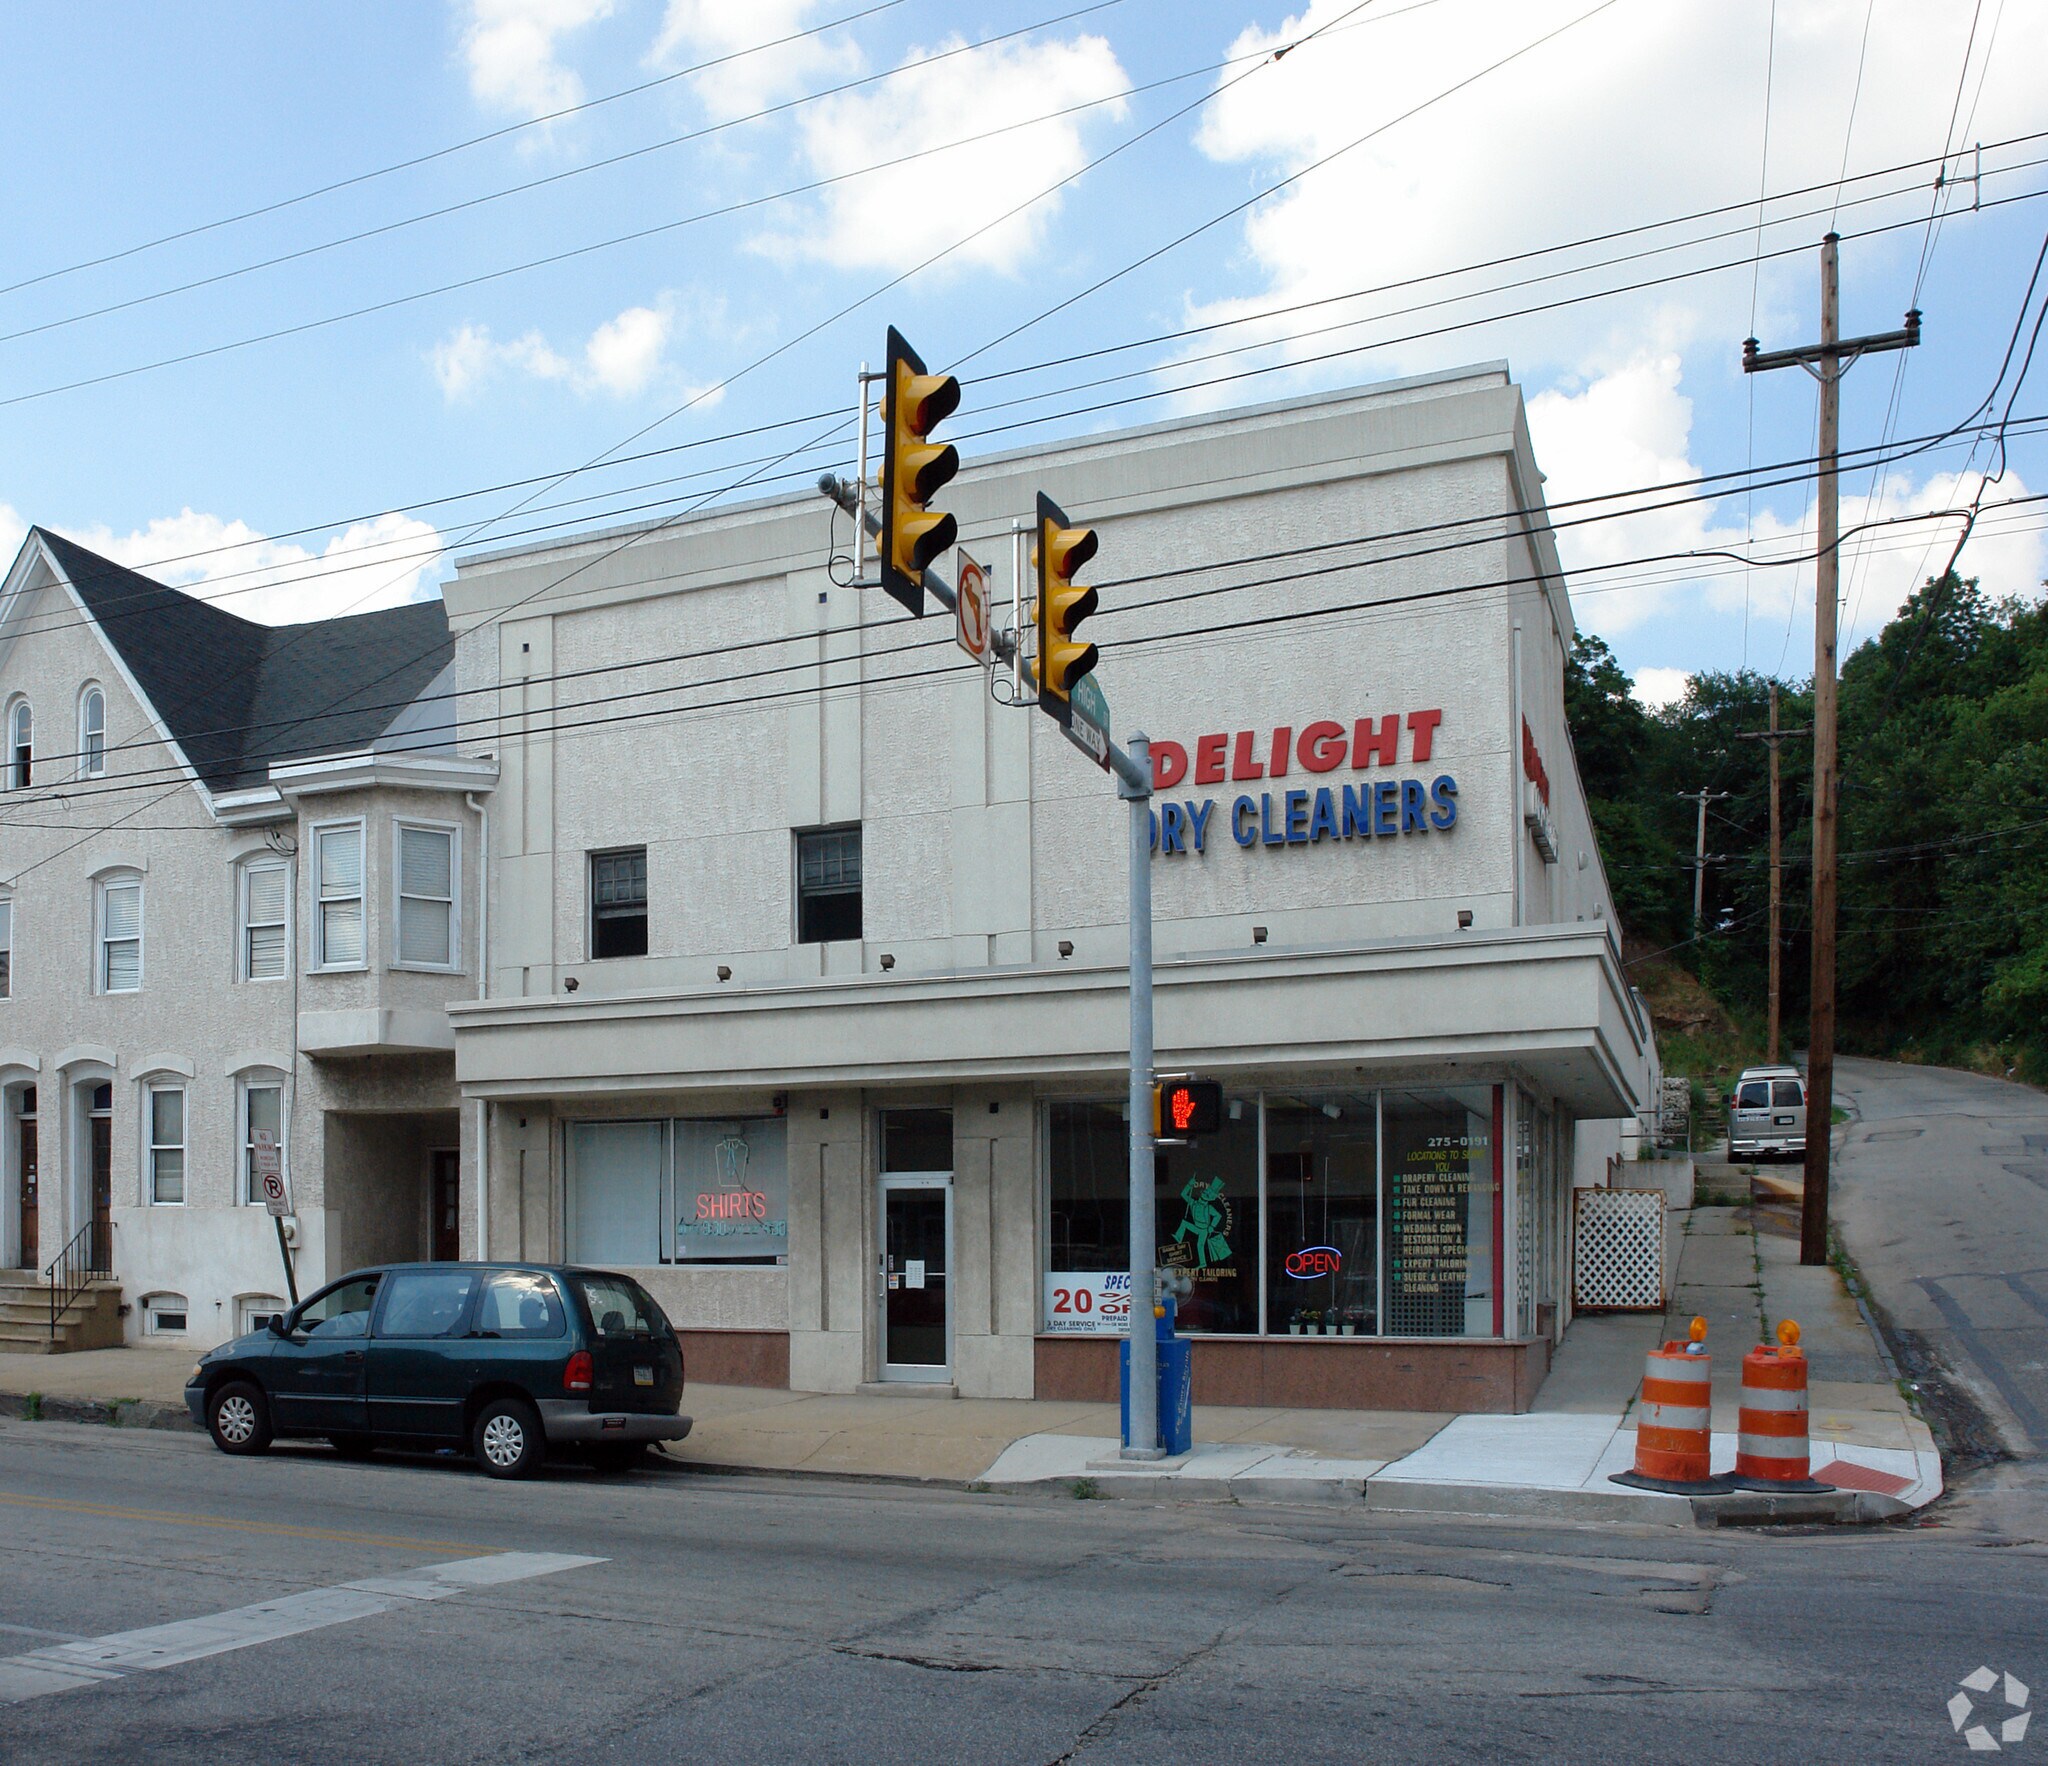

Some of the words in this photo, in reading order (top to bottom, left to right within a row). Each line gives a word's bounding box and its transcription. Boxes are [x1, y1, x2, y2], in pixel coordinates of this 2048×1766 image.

[1078, 680, 1096, 716] HIGH
[1086, 726, 1100, 754] WAY
[1149, 709, 1442, 791] DELIGHT
[1231, 775, 1458, 848] CLEANERS
[1427, 1136, 1488, 1147] 275-0191
[1407, 1150, 1446, 1161] LOCATIONS
[1450, 1150, 1459, 1160] TO
[1435, 1162, 1450, 1172] YOU
[1402, 1173, 1436, 1183] DRAPERY
[1439, 1172, 1476, 1182] CLEANING
[1403, 1185, 1421, 1194] TAKE
[1424, 1184, 1446, 1194] DOWN
[1449, 1184, 1454, 1193] &
[696, 1192, 766, 1218] SHIRTS
[1402, 1198, 1417, 1207] FUR
[1420, 1197, 1456, 1206] CLEANING
[1217, 1193, 1233, 1237] CLEANERS
[1402, 1211, 1432, 1220] FORMAL
[1434, 1210, 1456, 1219] WEAR
[1403, 1224, 1437, 1233] WEDDING
[1440, 1224, 1462, 1233] GOWN
[1403, 1235, 1453, 1244] RESTORATION
[1403, 1245, 1440, 1255] HEIRLOOM
[1285, 1253, 1340, 1272] OPEN
[1404, 1259, 1431, 1268] EXPERT
[1435, 1258, 1473, 1268] TAILORING
[1202, 1268, 1237, 1277] TAILORING
[1404, 1272, 1427, 1282] SUEDE
[1439, 1271, 1472, 1281] LEATHER
[1104, 1275, 1130, 1289] SPEC
[1404, 1283, 1439, 1293] CLEANING
[1053, 1289, 1092, 1313] 20
